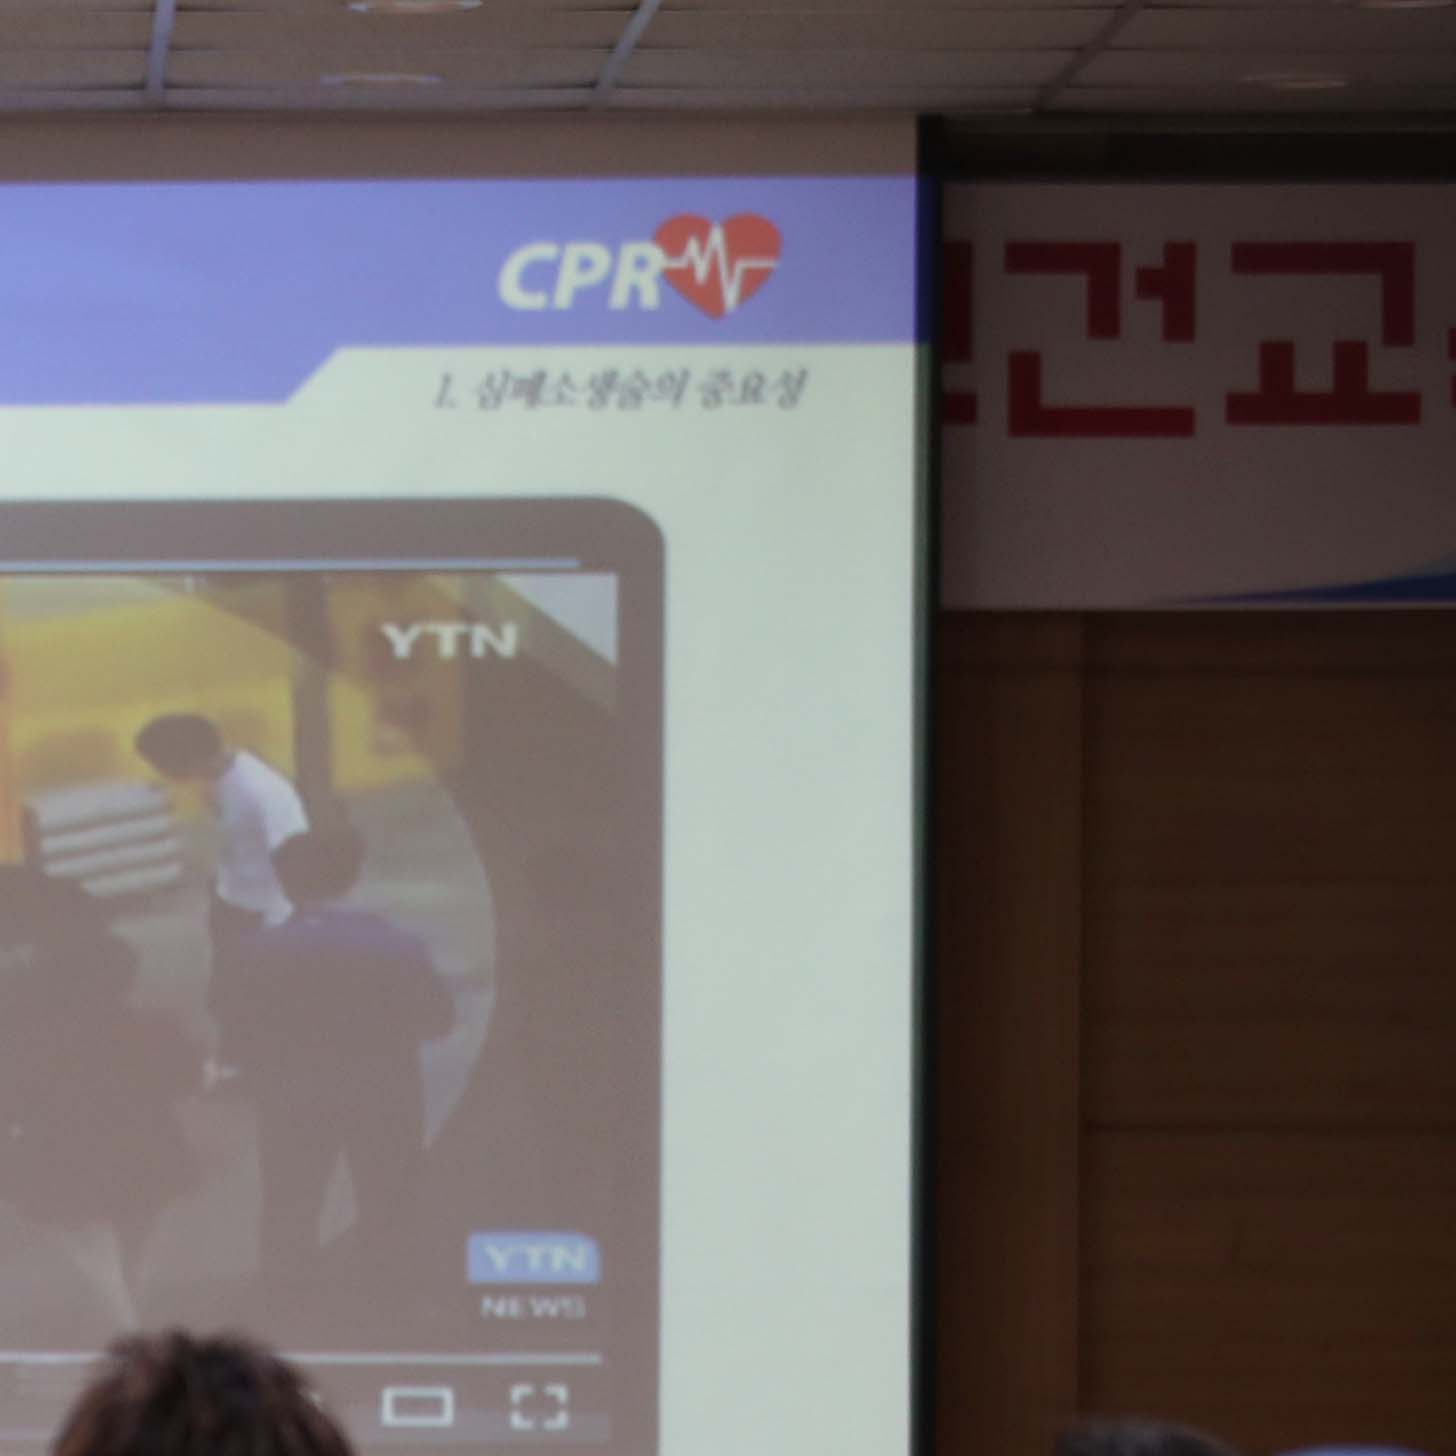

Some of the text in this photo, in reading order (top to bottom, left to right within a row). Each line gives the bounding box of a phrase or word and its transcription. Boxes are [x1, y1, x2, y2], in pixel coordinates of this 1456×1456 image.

[498, 241, 665, 311] CPR
[943, 240, 1456, 437] 건교
[381, 620, 520, 660] YTN
[483, 1243, 587, 1272] YTN
